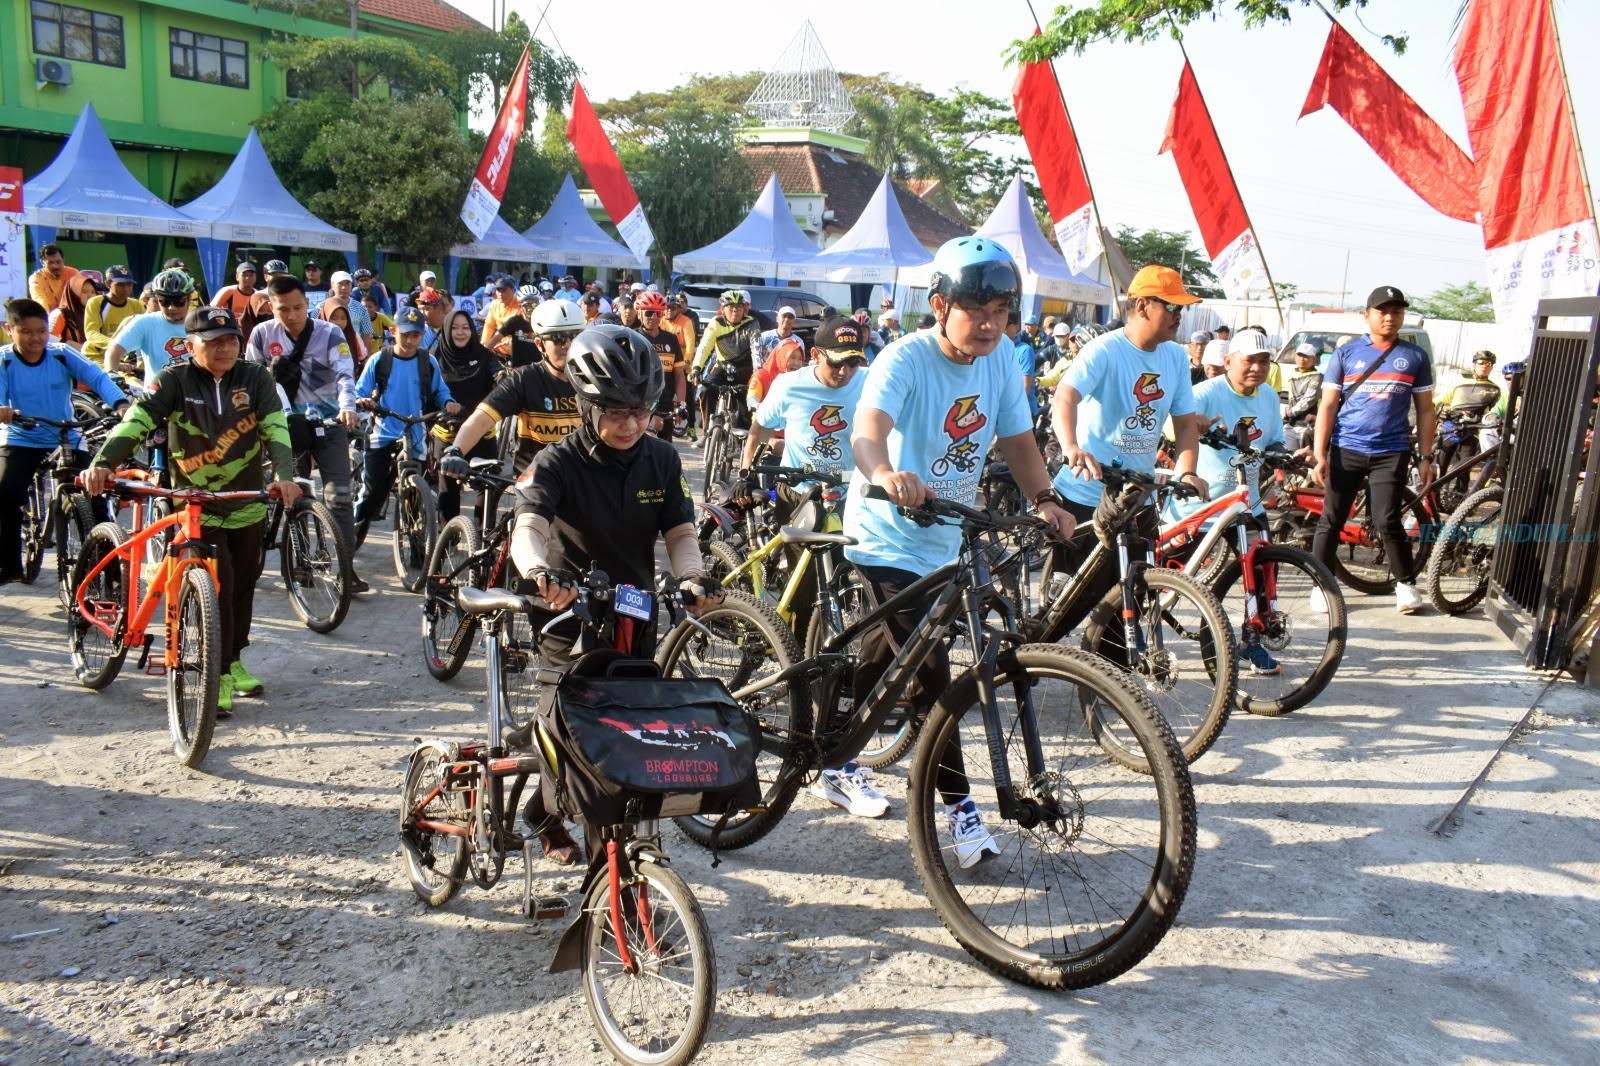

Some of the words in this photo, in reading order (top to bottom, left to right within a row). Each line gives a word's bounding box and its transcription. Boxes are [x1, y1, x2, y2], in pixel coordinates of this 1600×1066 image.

[645, 758, 719, 774] BROMPTON
[1038, 965, 1070, 975] TEAM
[1072, 953, 1105, 973] ISSUE
